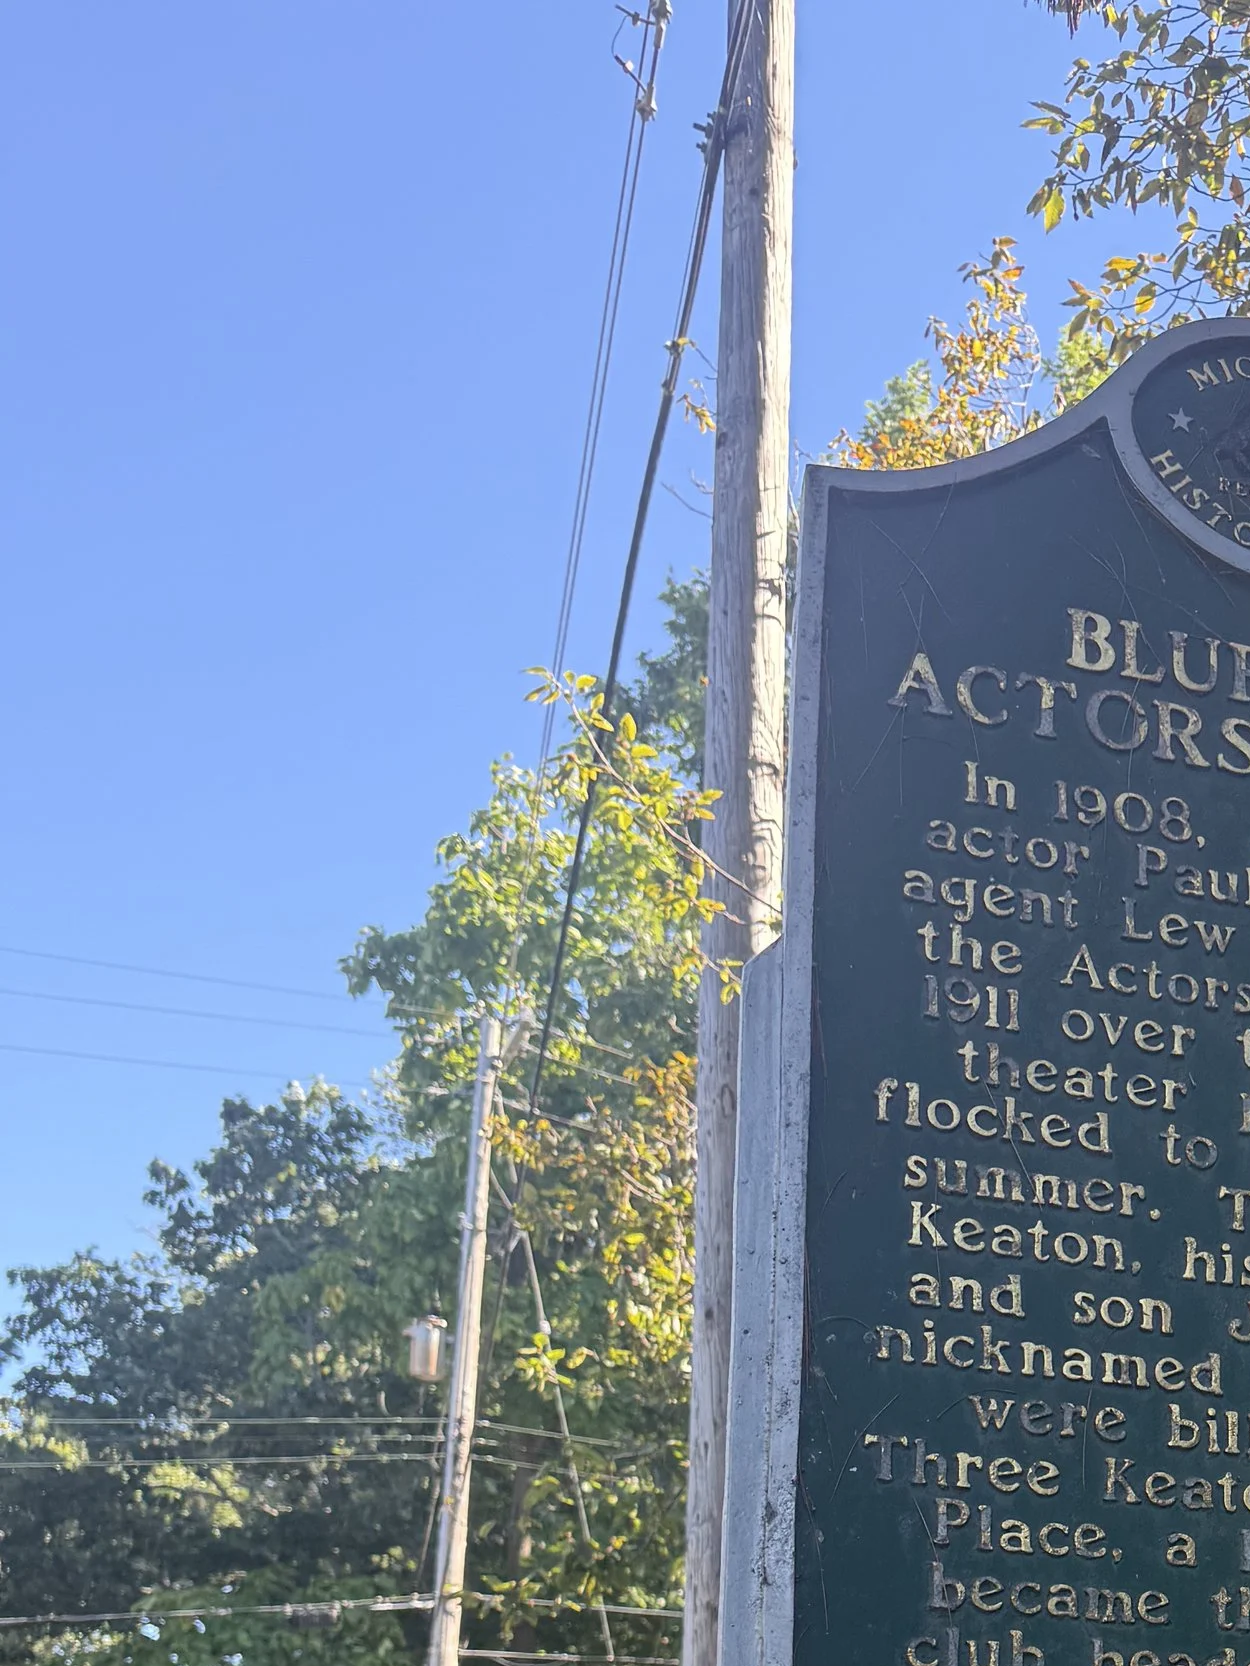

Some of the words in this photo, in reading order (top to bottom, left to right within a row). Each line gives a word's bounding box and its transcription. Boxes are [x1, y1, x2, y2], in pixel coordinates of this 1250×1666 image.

[964, 760, 1017, 811] In
[1054, 780, 1205, 848] 1908,
[926, 819, 1090, 877] actor
[904, 870, 1078, 928] agent
[1121, 897, 1235, 952] Lew
[917, 921, 1022, 974] the
[924, 975, 1020, 1031] 1911
[1061, 1009, 1195, 1056] over
[957, 1040, 1188, 1110] theater
[874, 1077, 1112, 1154] flocked
[1159, 1124, 1218, 1169] to
[904, 1155, 1161, 1220] summer.
[907, 1201, 1141, 1274] Keaton,
[908, 1273, 1025, 1318] and
[1073, 1292, 1174, 1334] son
[875, 1319, 1223, 1397] nicknamed
[969, 1396, 1127, 1441] were
[864, 1433, 1059, 1495] Three
[934, 1498, 1123, 1563] Place,
[1166, 1533, 1198, 1567] a
[928, 1561, 1170, 1624] became
